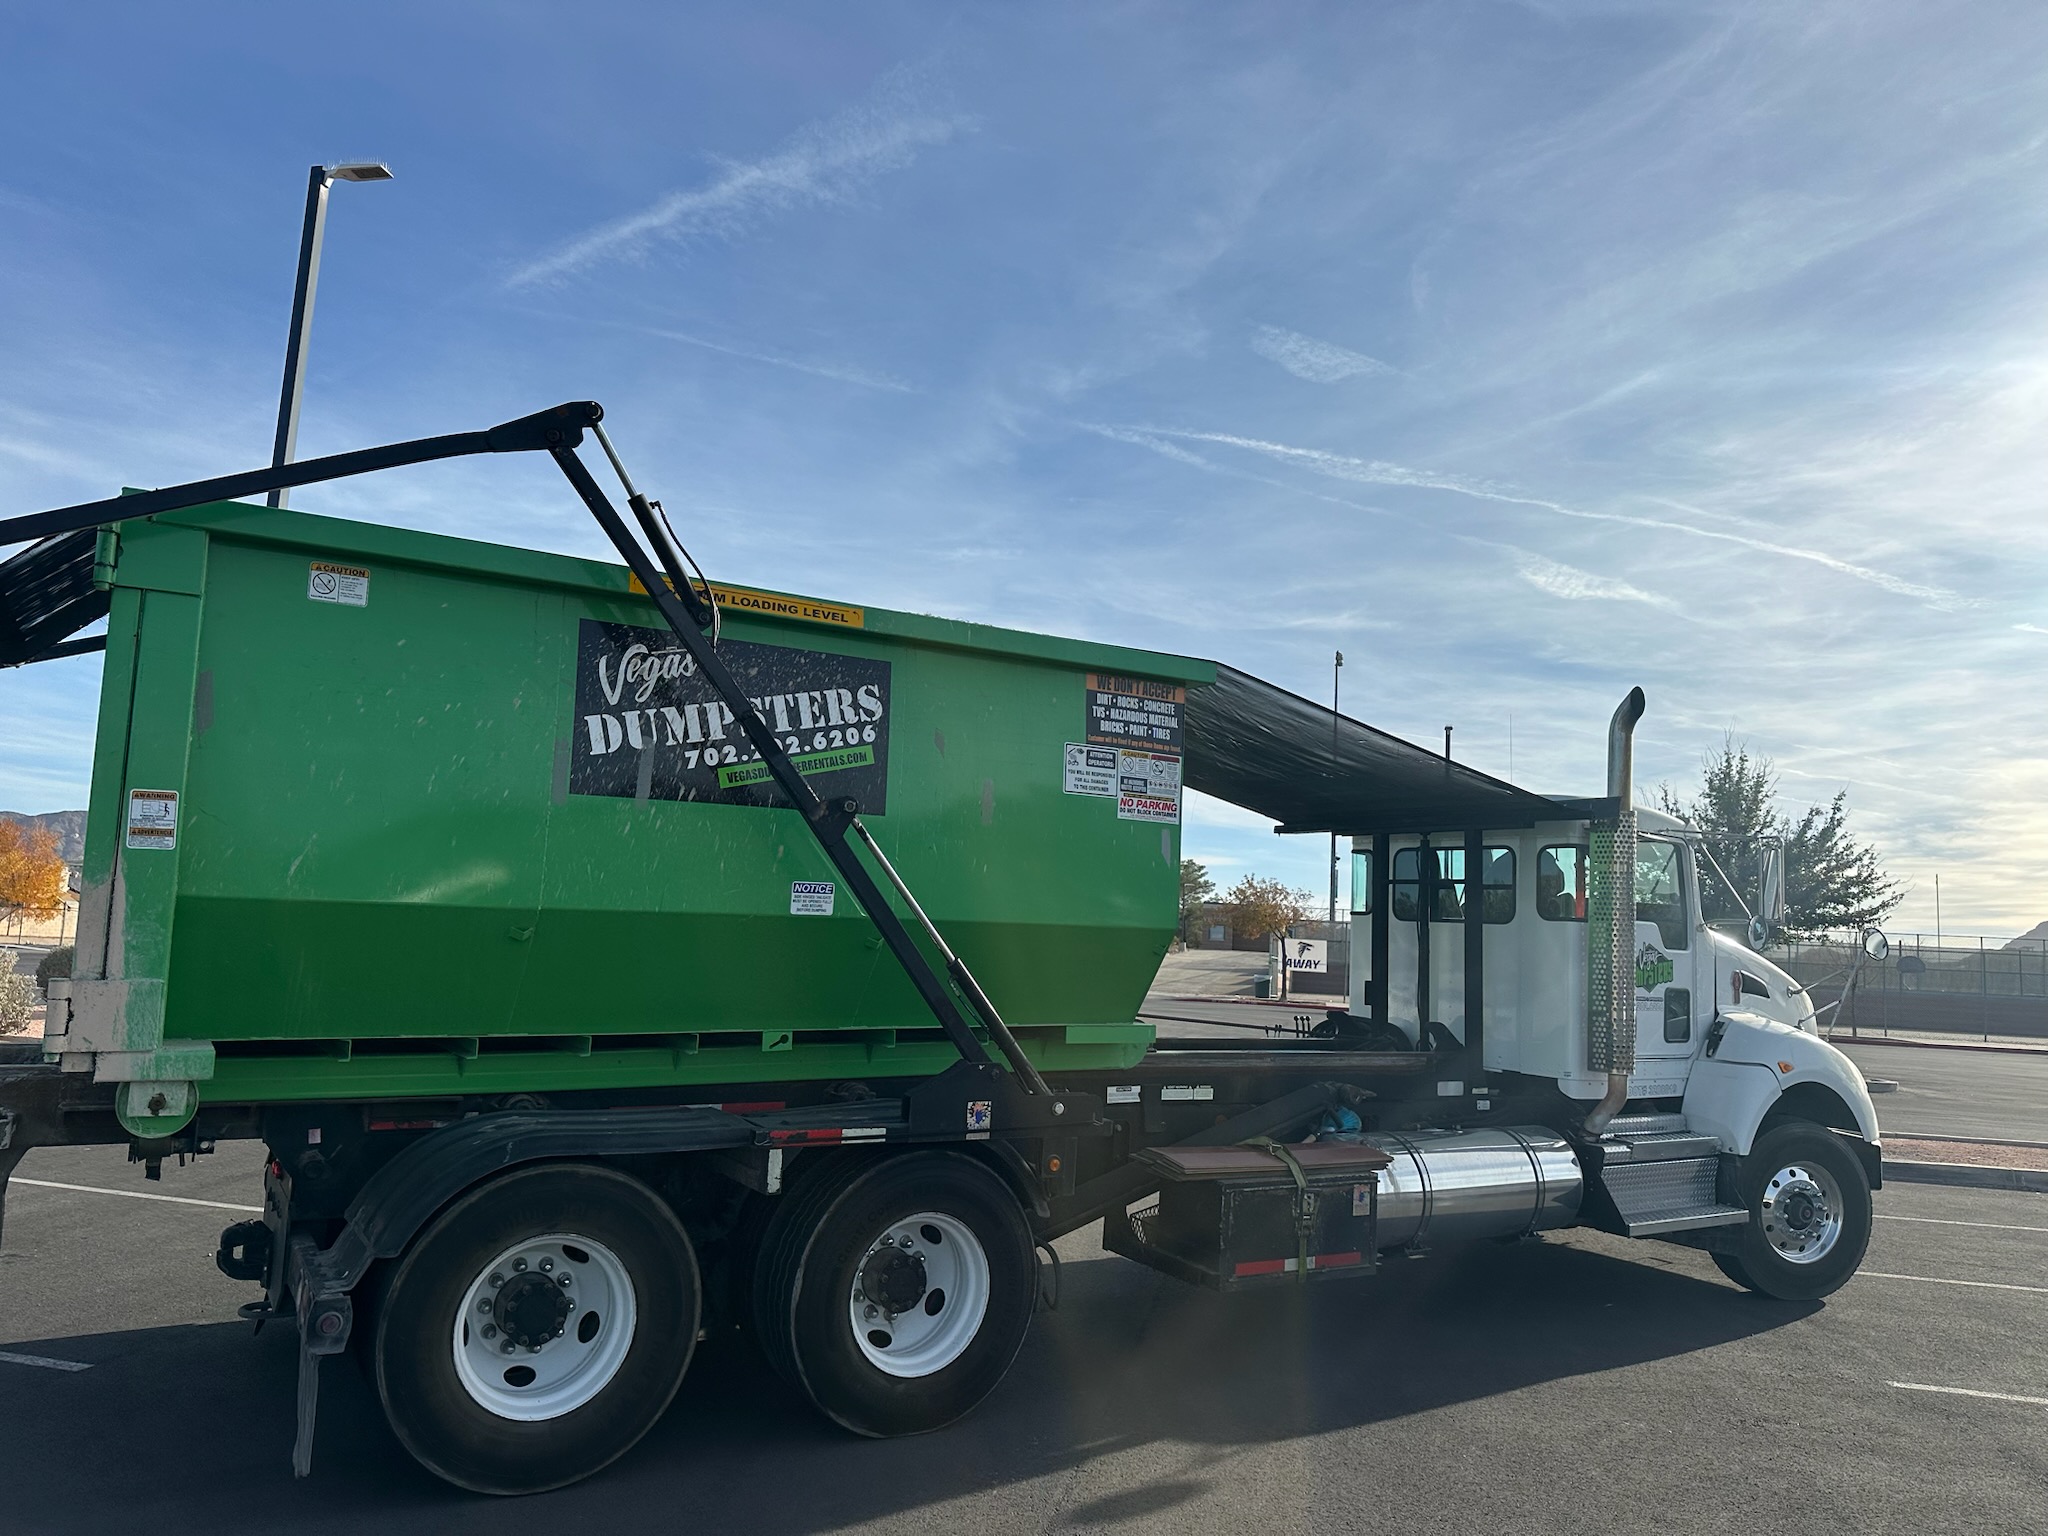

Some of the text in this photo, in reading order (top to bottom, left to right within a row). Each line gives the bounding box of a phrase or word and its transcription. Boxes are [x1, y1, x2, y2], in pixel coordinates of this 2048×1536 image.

[324, 565, 365, 577] CAUTION
[731, 594, 799, 614] LOADING
[803, 607, 849, 623] LEVEL
[599, 644, 698, 705] Vegas
[1096, 675, 1112, 691] WE
[1142, 681, 1177, 700] ACCEPT
[1096, 693, 1175, 715] DIRT ROCKS CONCRETE
[1110, 708, 1148, 724] HAZARDOUS
[1148, 714, 1178, 728] MATERIAL
[1100, 720, 1171, 740] BRICKS PAINT TIRES
[684, 724, 877, 770] 702.2.6206
[726, 751, 868, 785] VEGASDUERRENTALS.COM
[1119, 797, 1134, 807] NO
[1136, 800, 1178, 812] PARKING
[1152, 810, 1177, 818] CONTAINER
[794, 883, 833, 894] NOTICE
[1286, 958, 1321, 969] AWAY
